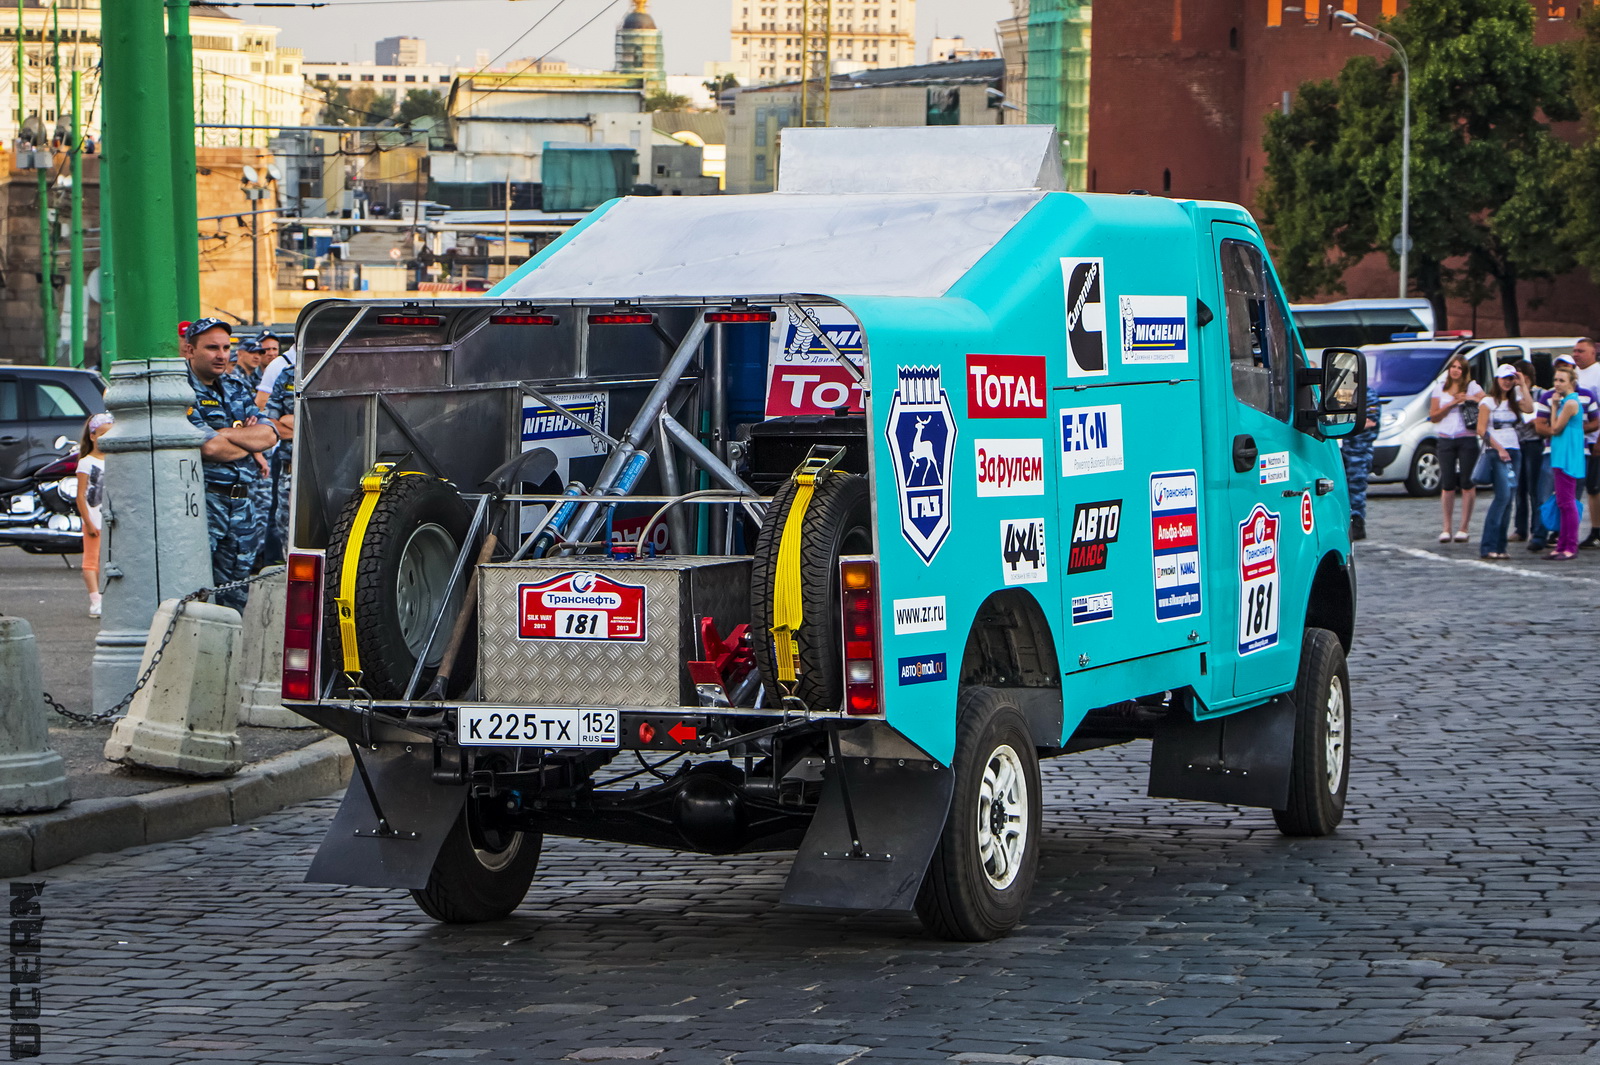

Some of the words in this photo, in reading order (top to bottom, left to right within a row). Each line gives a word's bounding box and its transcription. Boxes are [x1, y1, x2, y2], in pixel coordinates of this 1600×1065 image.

[1068, 262, 1098, 332] Cummins
[1135, 323, 1185, 341] MICHELIN
[969, 365, 1044, 408] TOTAL
[1061, 411, 1108, 453] EATON
[179, 459, 200, 483] ГК
[977, 447, 1043, 489] Зарулем
[185, 492, 199, 518] 16
[1162, 487, 1194, 502] Транснефть
[910, 495, 941, 519] ГАЗ
[1303, 499, 1311, 525] E
[1072, 504, 1120, 544] АВТО
[1157, 522, 1193, 542] Альфа-Банк
[1070, 543, 1106, 569] ПЛЮС
[547, 593, 616, 605] Транснефть
[1246, 581, 1273, 637] 181
[565, 613, 599, 635] 181
[896, 604, 944, 626] www.zr.ru
[901, 660, 944, 678] АВТО@mail.ru
[582, 712, 615, 734] 152
[582, 735, 600, 743] RUS
